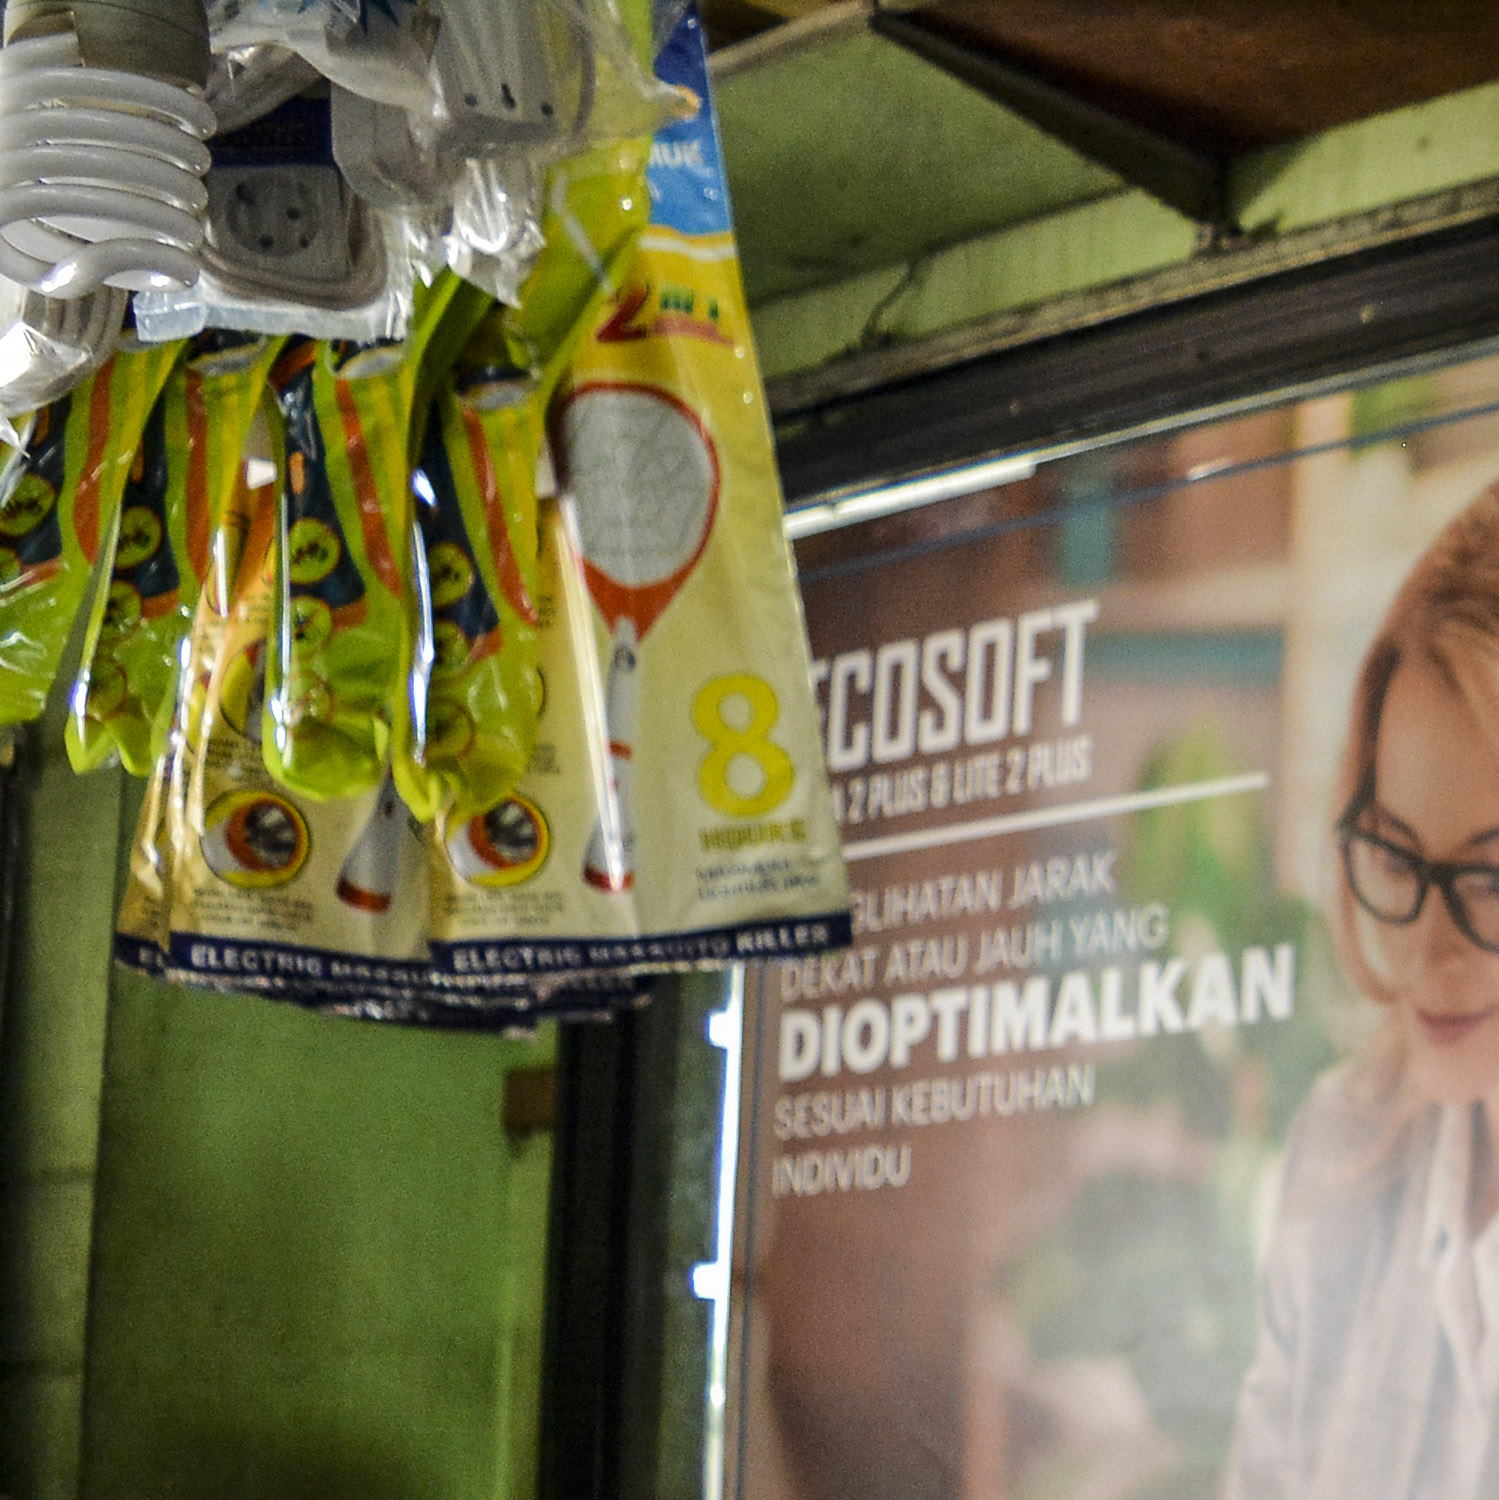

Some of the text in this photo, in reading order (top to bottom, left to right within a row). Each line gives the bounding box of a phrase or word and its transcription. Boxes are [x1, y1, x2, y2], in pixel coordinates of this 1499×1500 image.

[693, 674, 796, 818] 8
[1008, 847, 1118, 907] JARAK
[883, 931, 969, 988] ATAU
[973, 919, 1060, 974] JAUH
[1069, 902, 1171, 953] YANG
[777, 942, 1300, 1084] DIOPTIMALKAN
[772, 1062, 1096, 1142] SESUAI KEBUTUHAN
[771, 1144, 913, 1198] INDIVIDU
